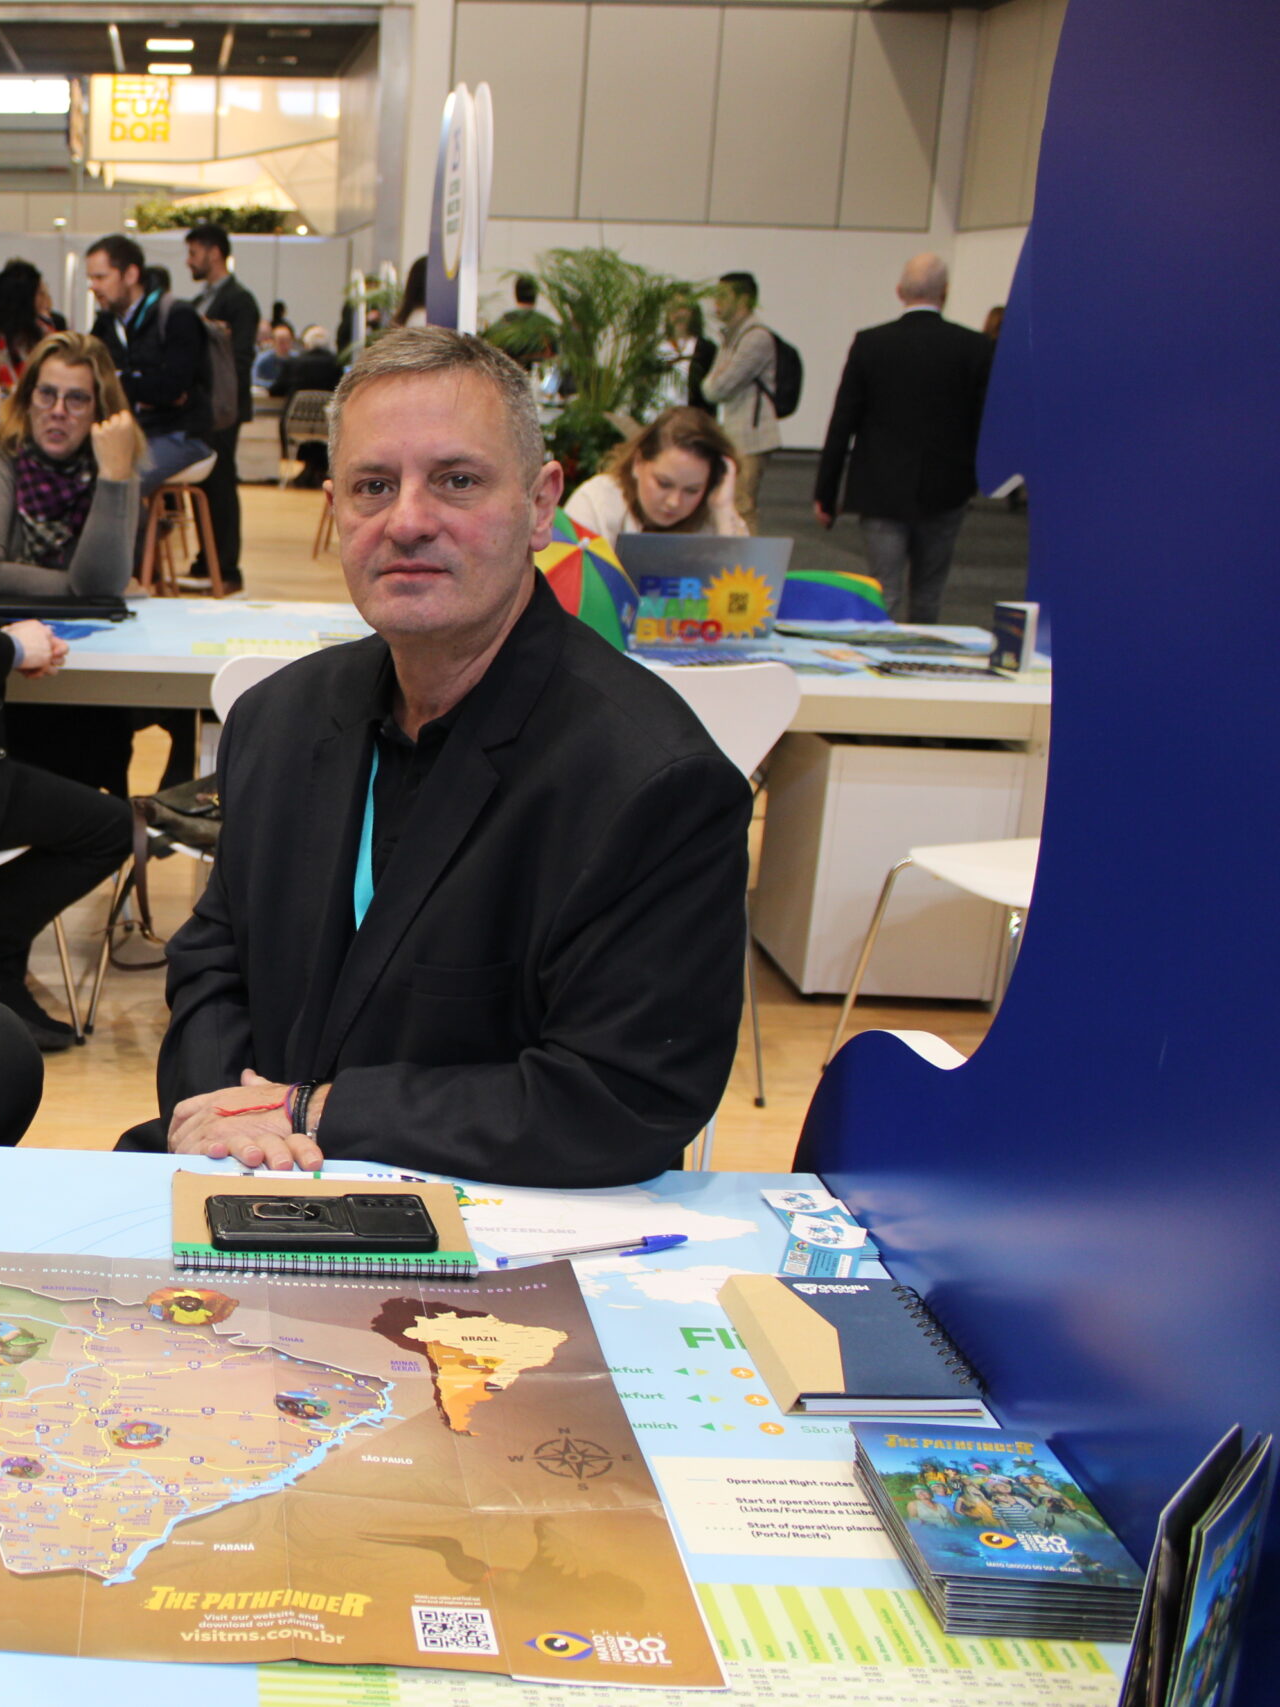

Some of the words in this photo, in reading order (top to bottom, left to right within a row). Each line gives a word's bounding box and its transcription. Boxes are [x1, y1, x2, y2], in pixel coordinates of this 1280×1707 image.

[112, 98, 170, 117] CUA
[110, 121, 170, 142] DOR
[639, 575, 702, 598] PER
[635, 618, 723, 643] BUCO
[475, 1226, 577, 1235] SWITZERLAND
[461, 1335, 498, 1343] BRAZIL
[679, 1326, 747, 1350] Fli
[608, 1366, 654, 1375] kfurt
[619, 1391, 666, 1400] kfurt
[558, 1427, 570, 1435] N
[631, 1421, 678, 1430] unich
[884, 1434, 919, 1449] THE
[361, 1453, 379, 1463] SÃO
[381, 1456, 413, 1465] PAULO
[578, 1483, 588, 1491] S
[726, 1477, 787, 1487] Operational
[789, 1478, 818, 1488] flight
[820, 1480, 855, 1488] routes
[735, 1497, 764, 1505] Start
[780, 1499, 830, 1508] operation
[846, 1508, 876, 1517] Lisbo
[747, 1522, 776, 1530] Start
[778, 1522, 788, 1530] of
[791, 1523, 843, 1533] operation
[213, 1541, 256, 1552] PARANÁ
[144, 1586, 200, 1611] THE
[201, 1589, 373, 1617] PATHFINDER
[204, 1613, 228, 1621] Visit
[253, 1610, 295, 1621] website
[298, 1612, 318, 1622] and
[199, 1621, 253, 1629] download
[281, 1618, 325, 1630] trainings
[180, 1628, 345, 1645] visitms.com.br
[619, 1636, 667, 1651] DO
[624, 1651, 673, 1665] SUL
